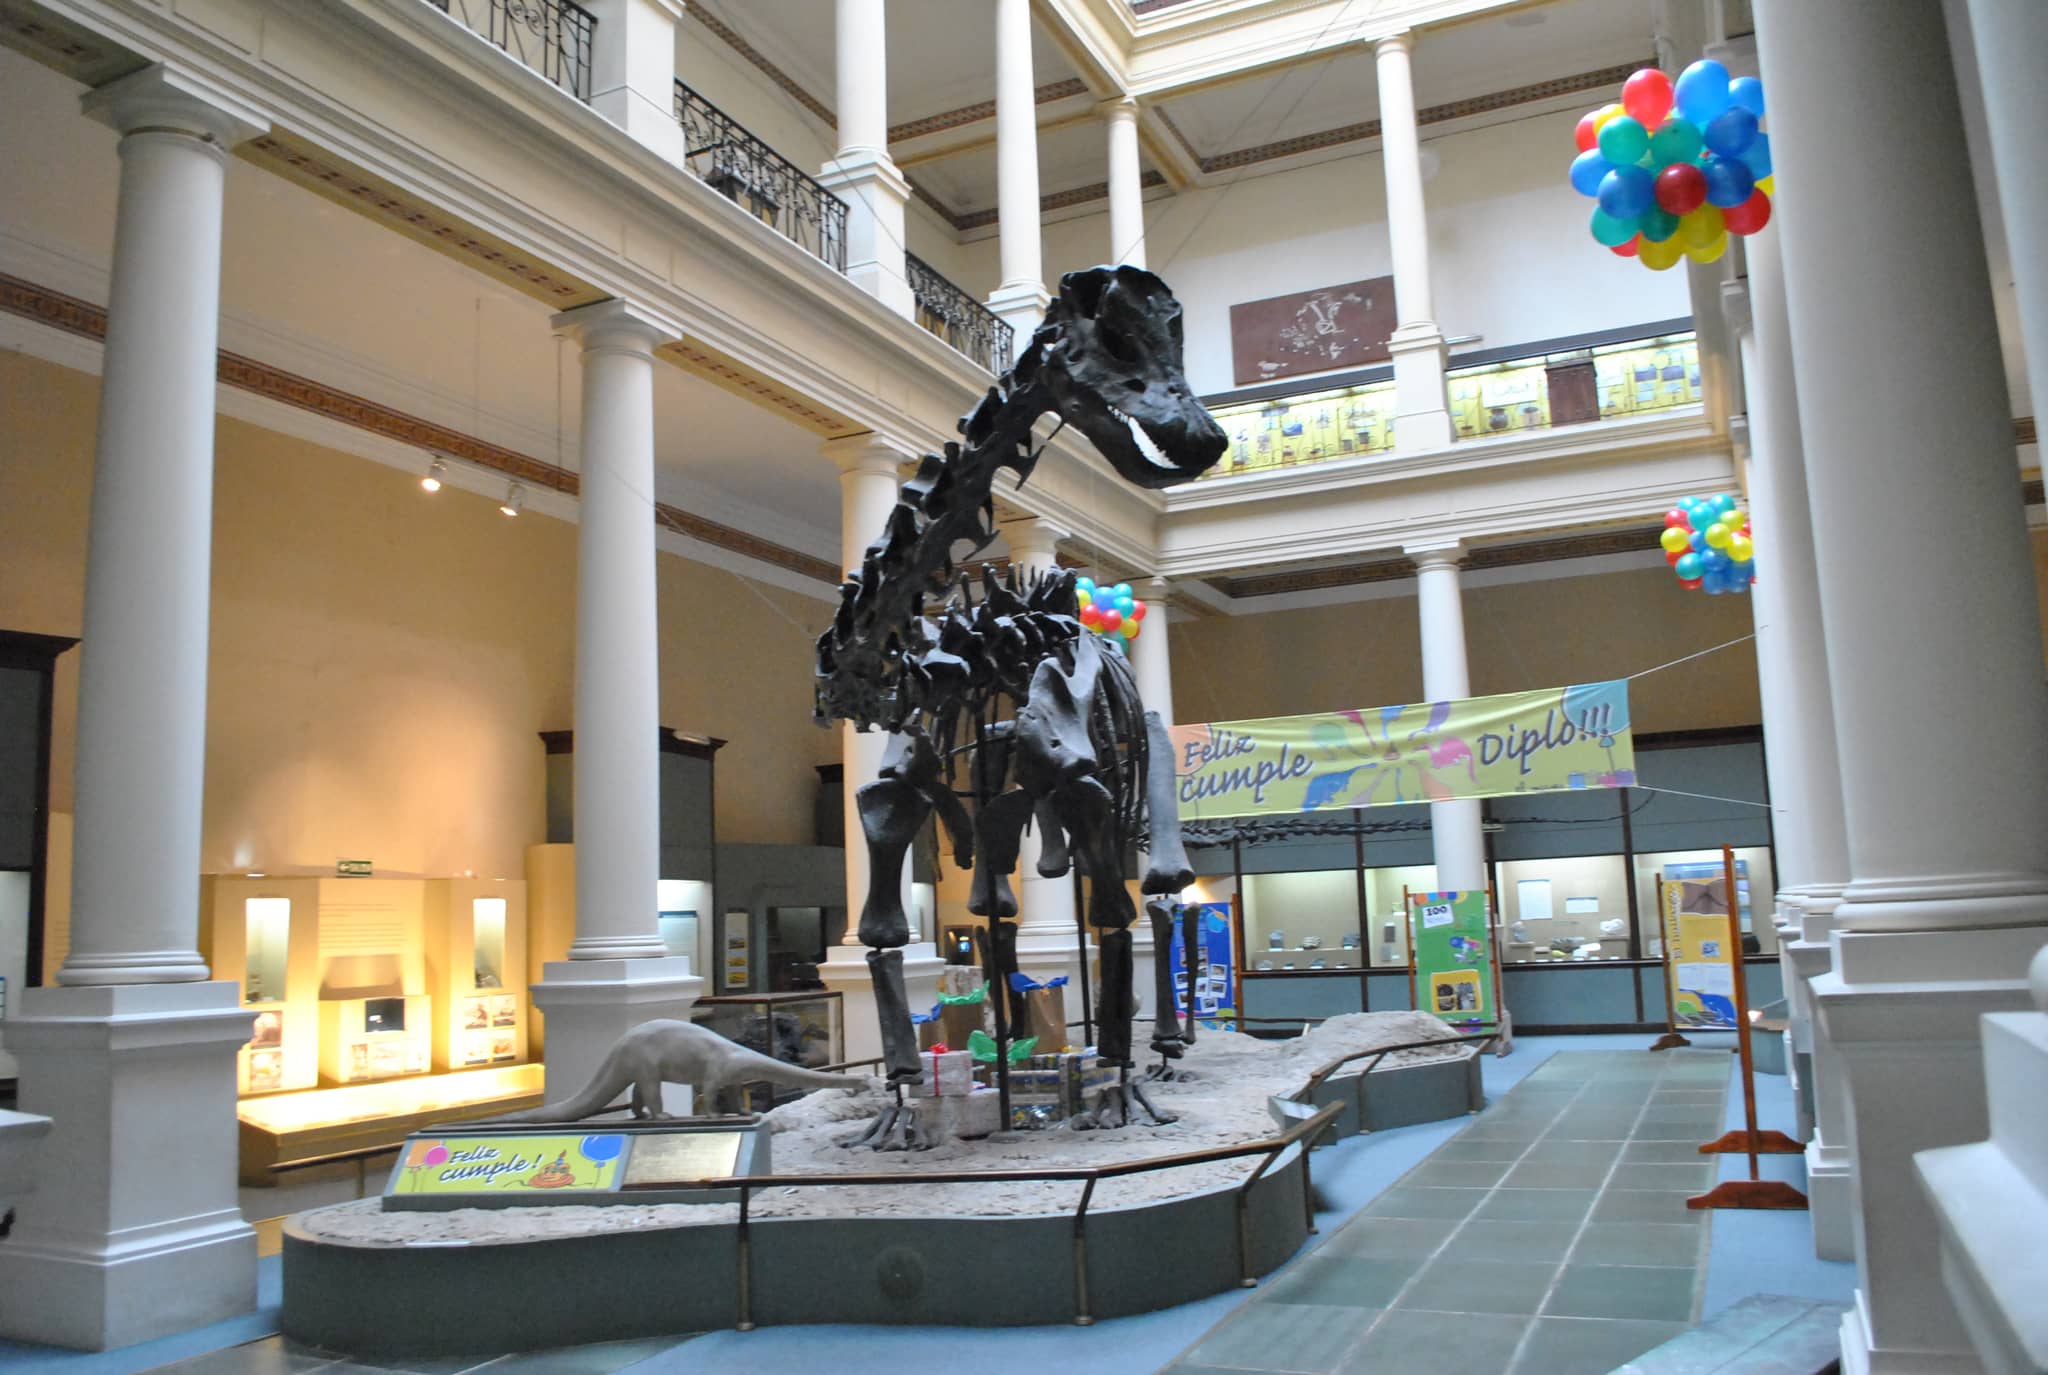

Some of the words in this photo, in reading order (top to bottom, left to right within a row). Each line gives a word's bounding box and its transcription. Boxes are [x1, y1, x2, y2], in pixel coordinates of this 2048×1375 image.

[1183, 730, 1257, 767] Feliz
[1477, 702, 1611, 776] Diplo!!!
[1180, 743, 1314, 804] cumple
[1427, 905, 1448, 916] 100
[439, 1153, 544, 1185] cumple!
[449, 1145, 501, 1165] Feliz
